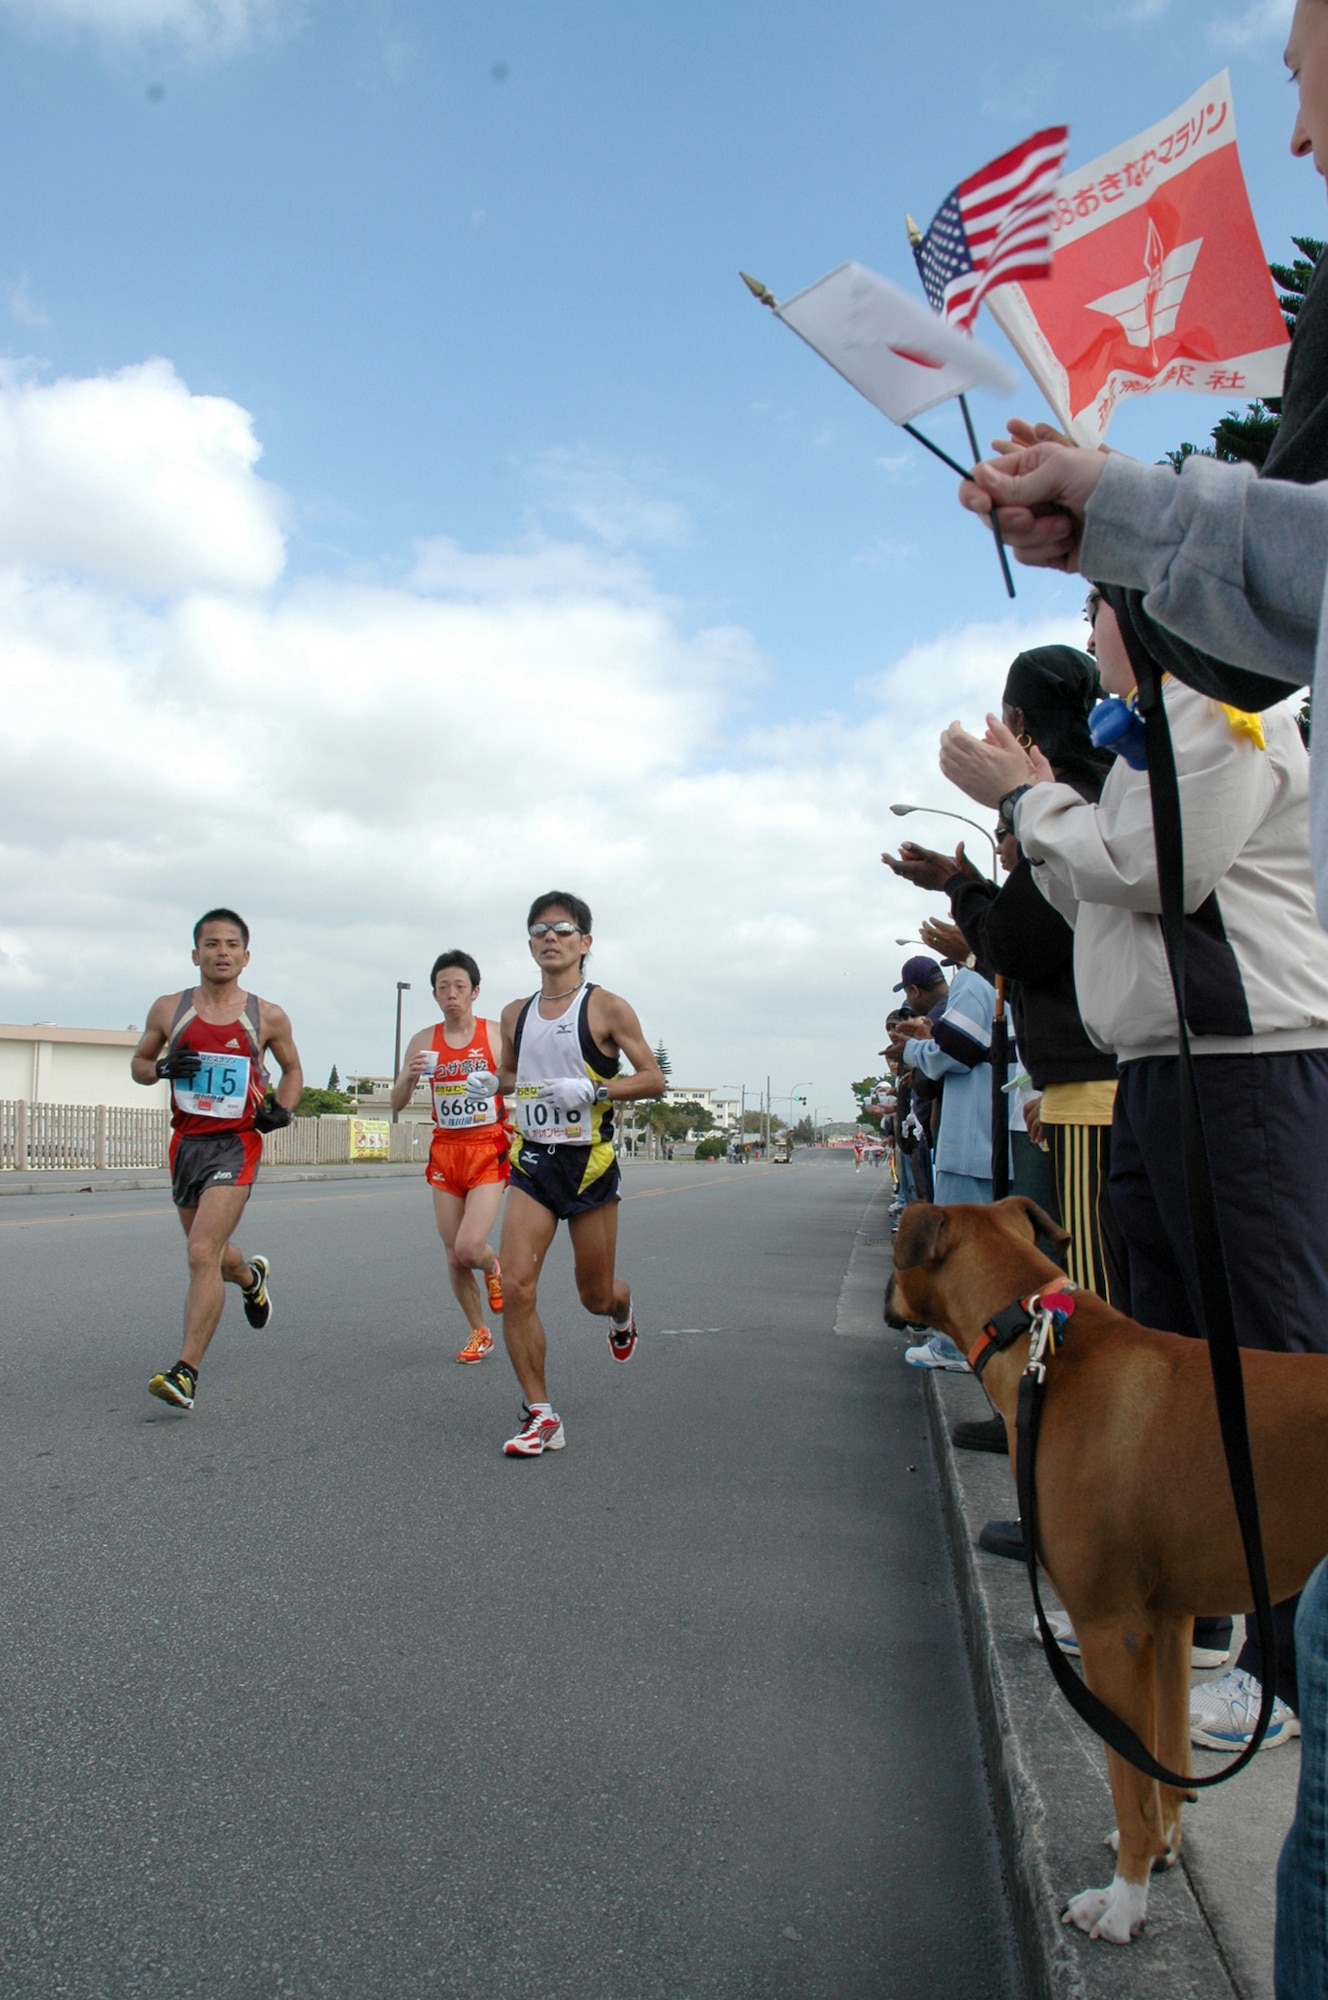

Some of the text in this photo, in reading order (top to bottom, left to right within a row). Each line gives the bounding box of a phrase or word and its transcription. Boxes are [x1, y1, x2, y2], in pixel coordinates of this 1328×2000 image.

[436, 1059, 488, 1078] コザ高校
[517, 1086, 545, 1096] おきな
